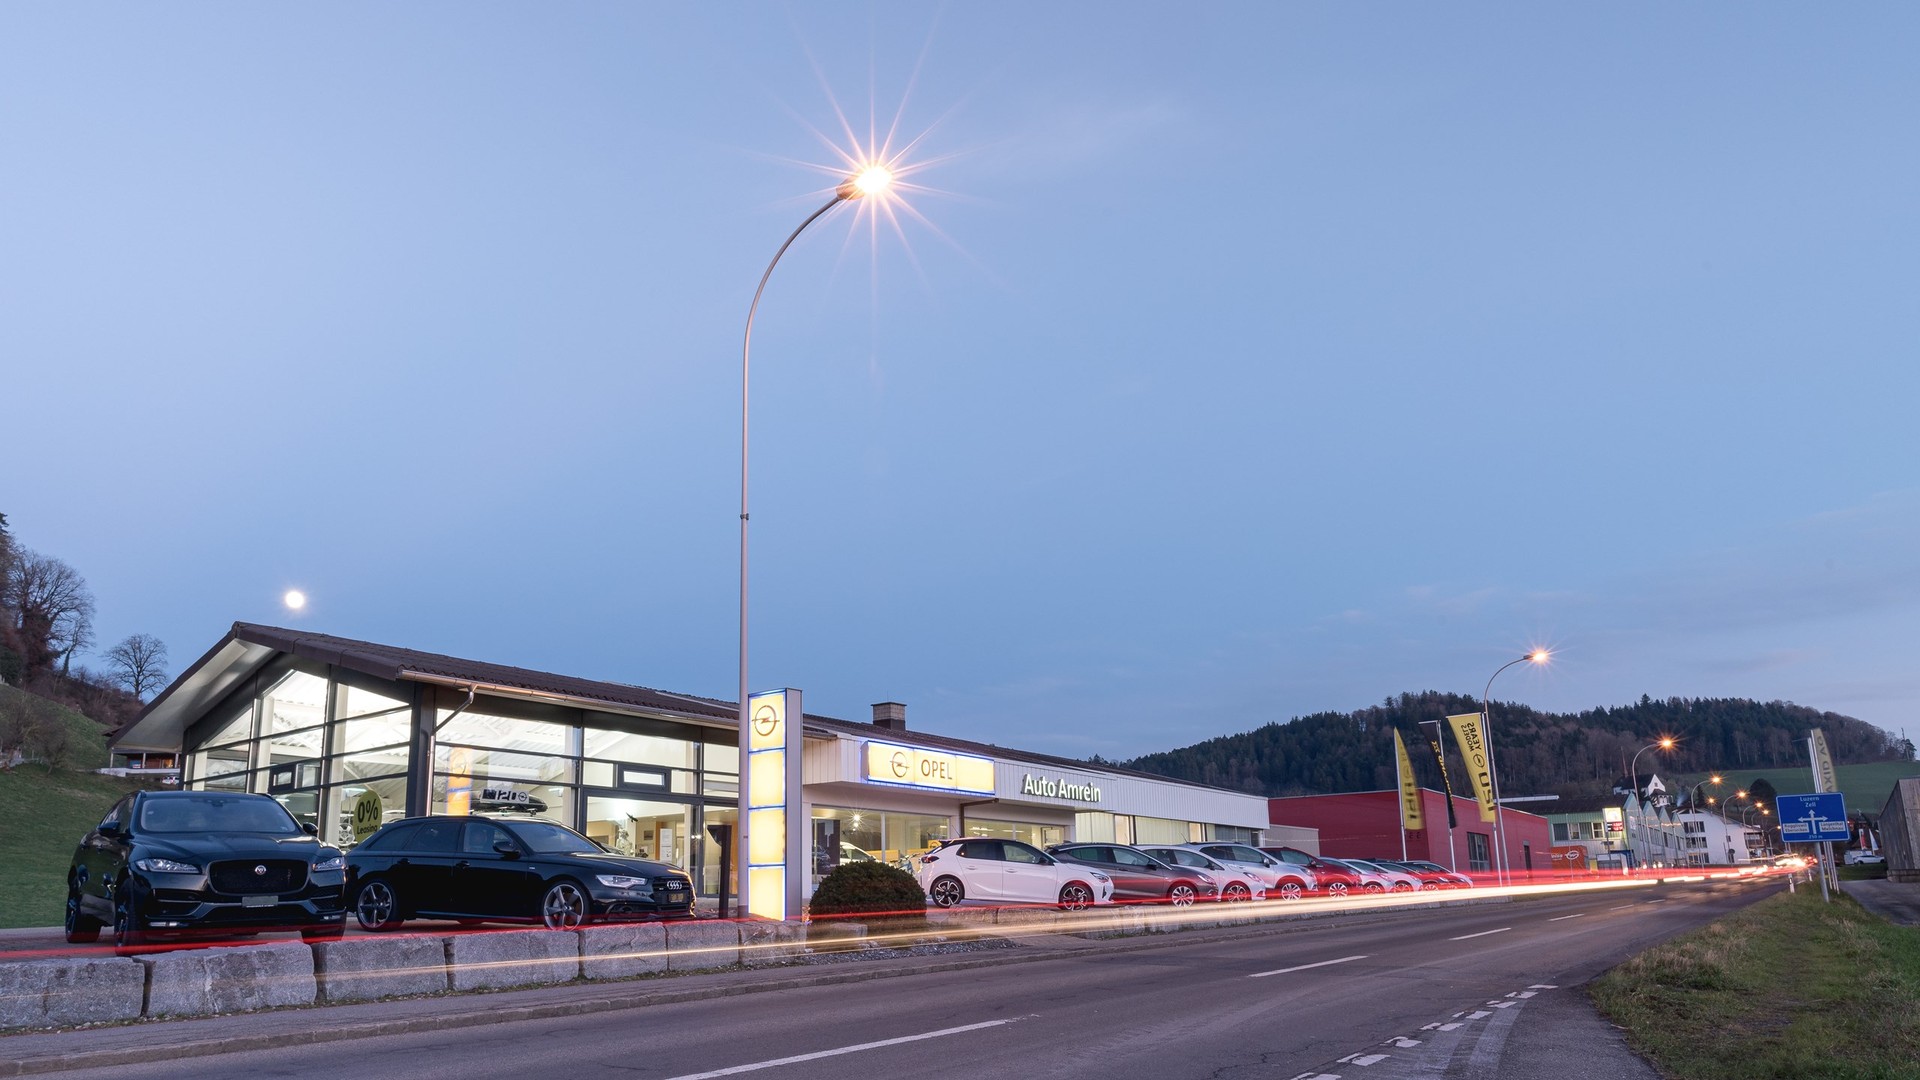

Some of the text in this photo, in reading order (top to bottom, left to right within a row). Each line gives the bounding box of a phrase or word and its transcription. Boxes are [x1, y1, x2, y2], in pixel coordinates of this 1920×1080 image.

[921, 759, 952, 780] OPEL
[1023, 773, 1101, 802] Auto Amrein
[357, 799, 379, 823] 0%
[357, 824, 378, 835] Leasing
